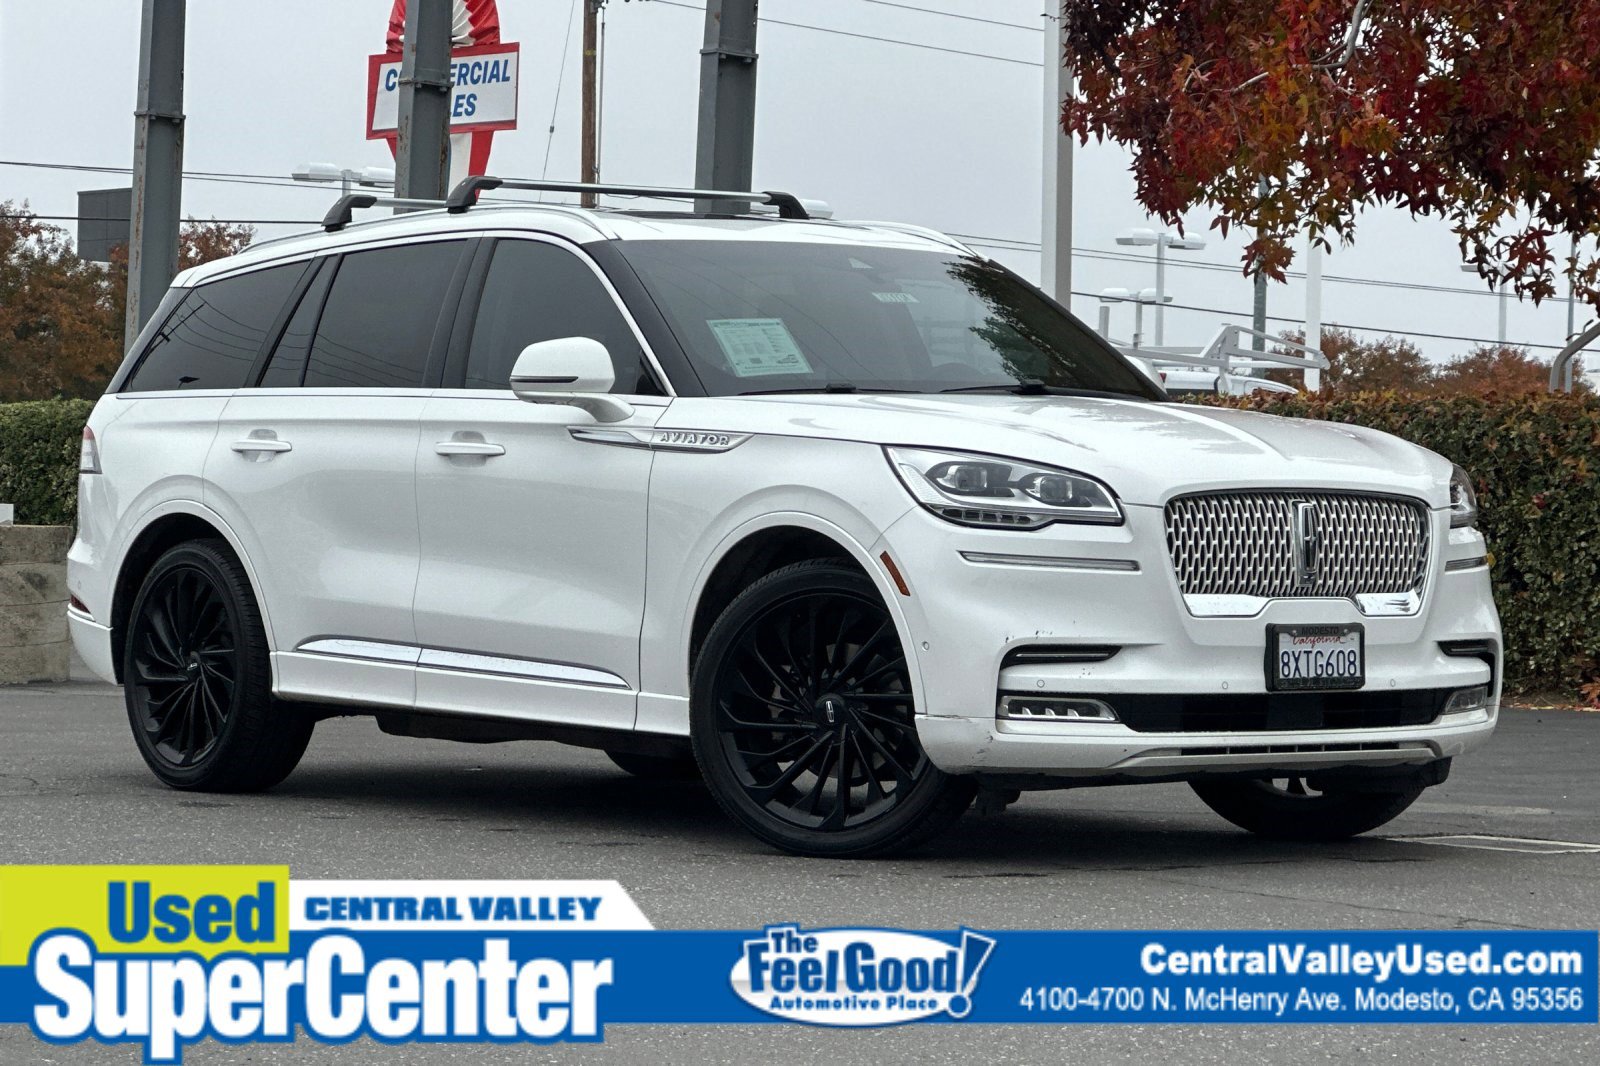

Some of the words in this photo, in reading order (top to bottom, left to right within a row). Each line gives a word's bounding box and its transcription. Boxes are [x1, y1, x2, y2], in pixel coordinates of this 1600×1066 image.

[660, 432, 730, 446] AVIATOR
[1301, 626, 1339, 635] MODESTO
[1292, 636, 1346, 648] California
[1281, 649, 1357, 678] 8XTG608
